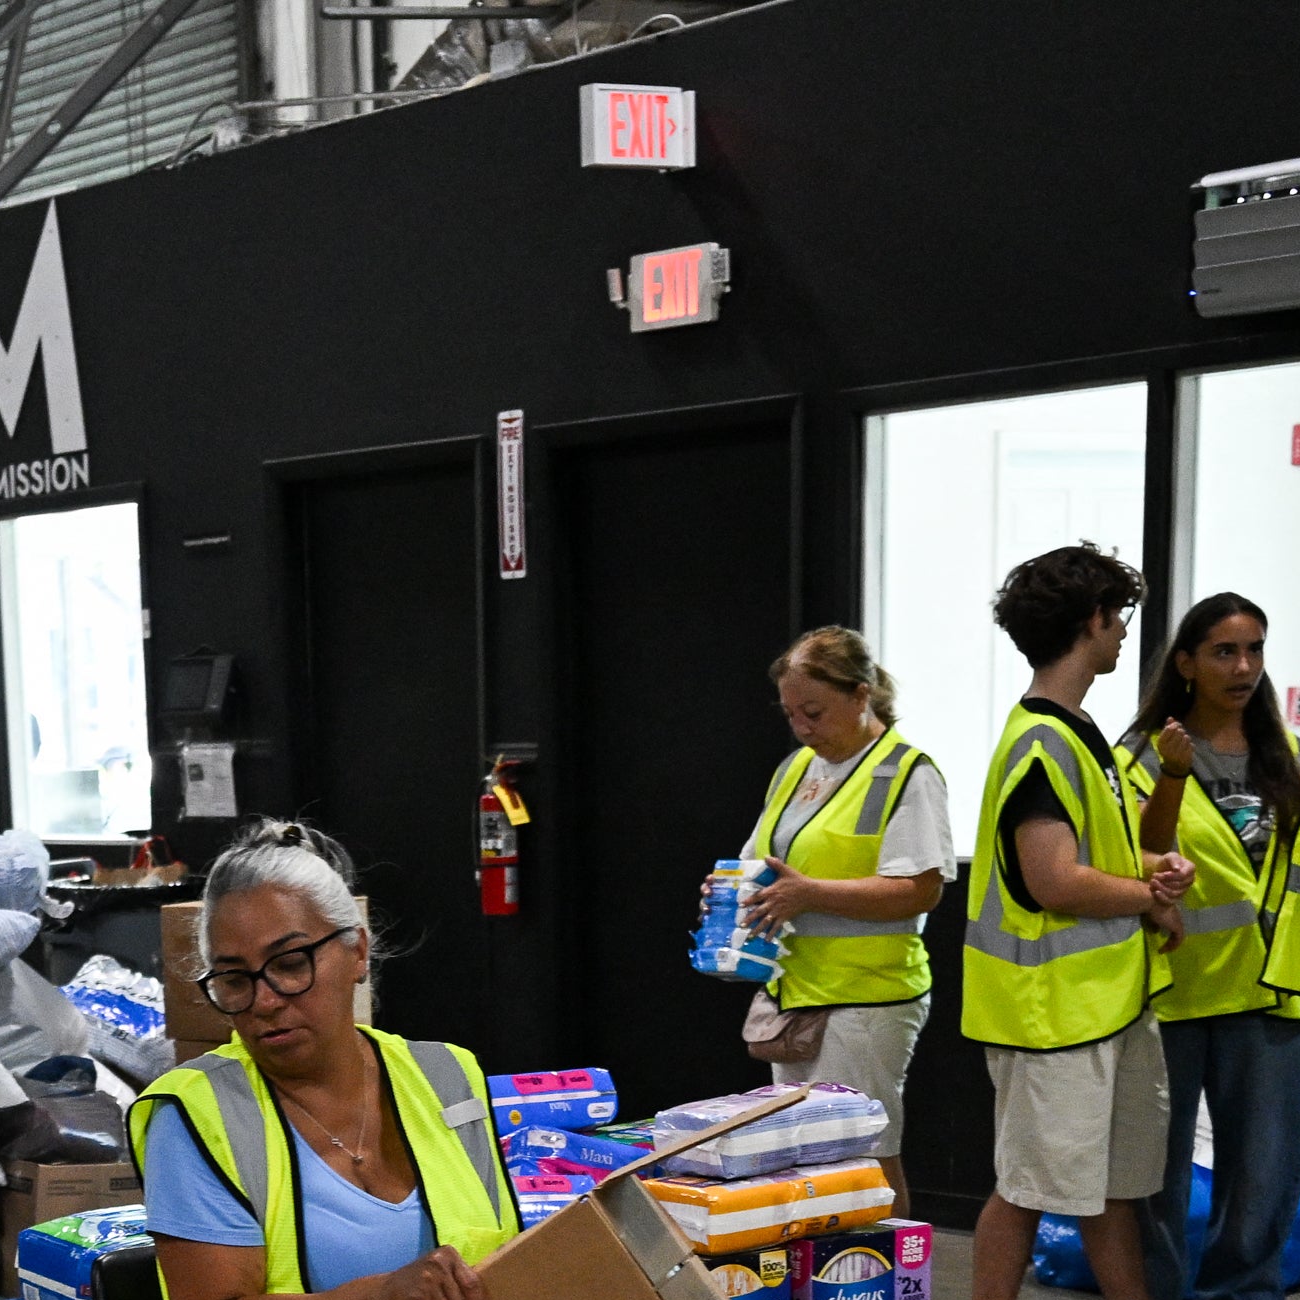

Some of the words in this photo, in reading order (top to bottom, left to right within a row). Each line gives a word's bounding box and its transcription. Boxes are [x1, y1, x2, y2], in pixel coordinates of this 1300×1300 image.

[608, 93, 671, 160] EXIT
[642, 246, 702, 323] EXIT
[502, 427, 520, 441] FIRE
[579, 1147, 613, 1165] Maxi
[902, 1235, 925, 1248] 35+
[902, 1246, 924, 1256] MORE
[901, 1254, 923, 1263] PADS
[762, 1262, 785, 1272] 100%
